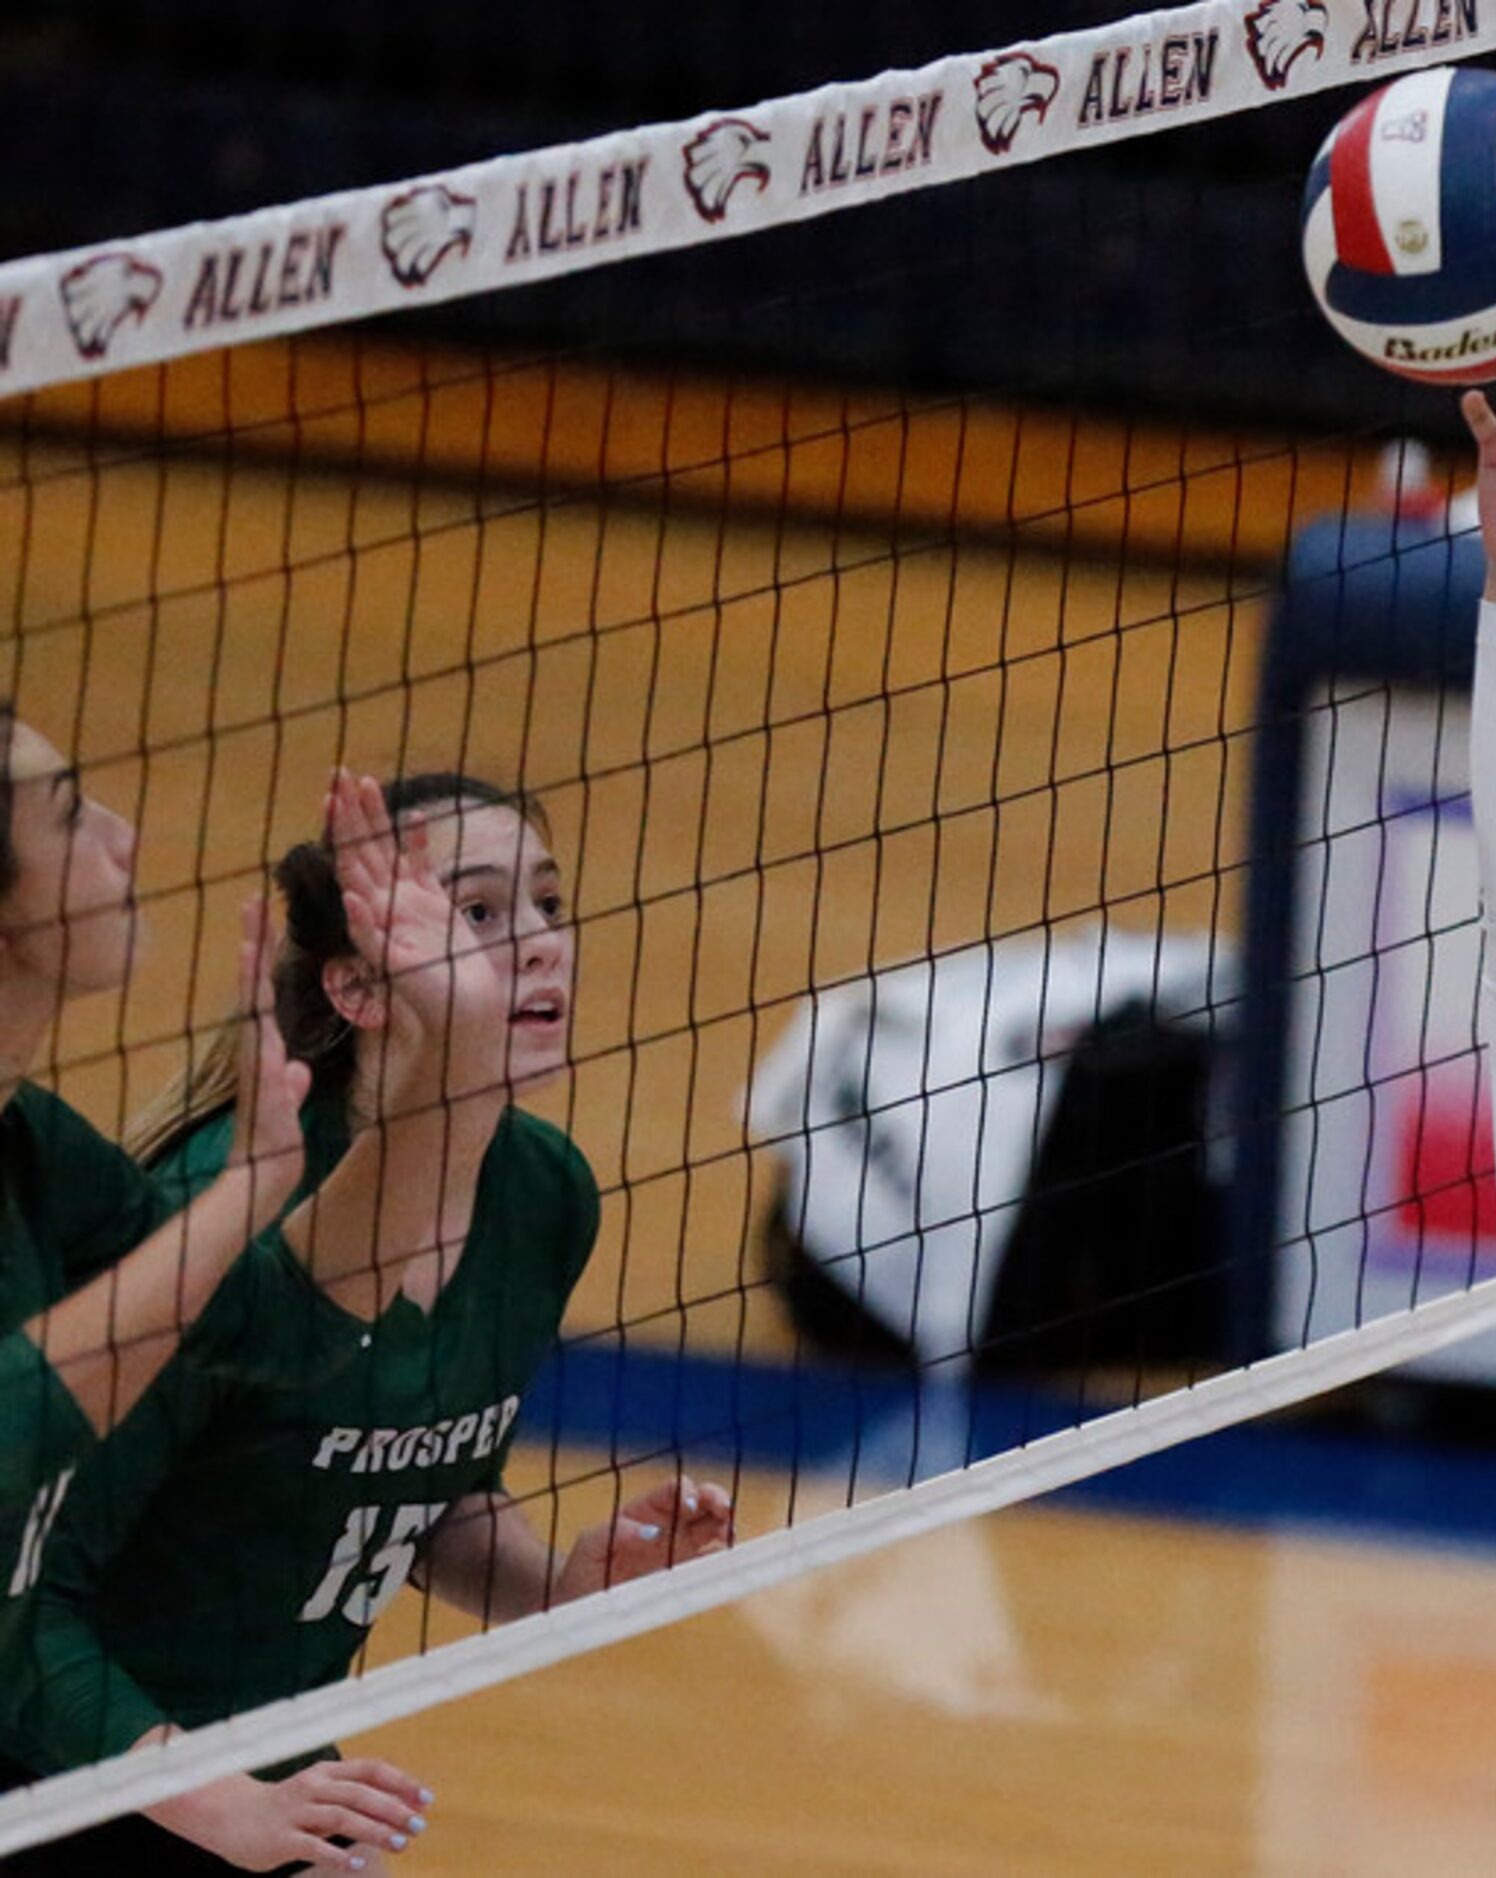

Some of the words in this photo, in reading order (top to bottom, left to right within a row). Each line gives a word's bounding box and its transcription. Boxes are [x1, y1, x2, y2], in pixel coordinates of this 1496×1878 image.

[184, 224, 346, 331] ALLEN
[506, 155, 651, 264] ALLEN
[800, 88, 944, 196] ALLEN
[1077, 28, 1219, 128] ALLEN
[296, 1502, 449, 1626] 15
